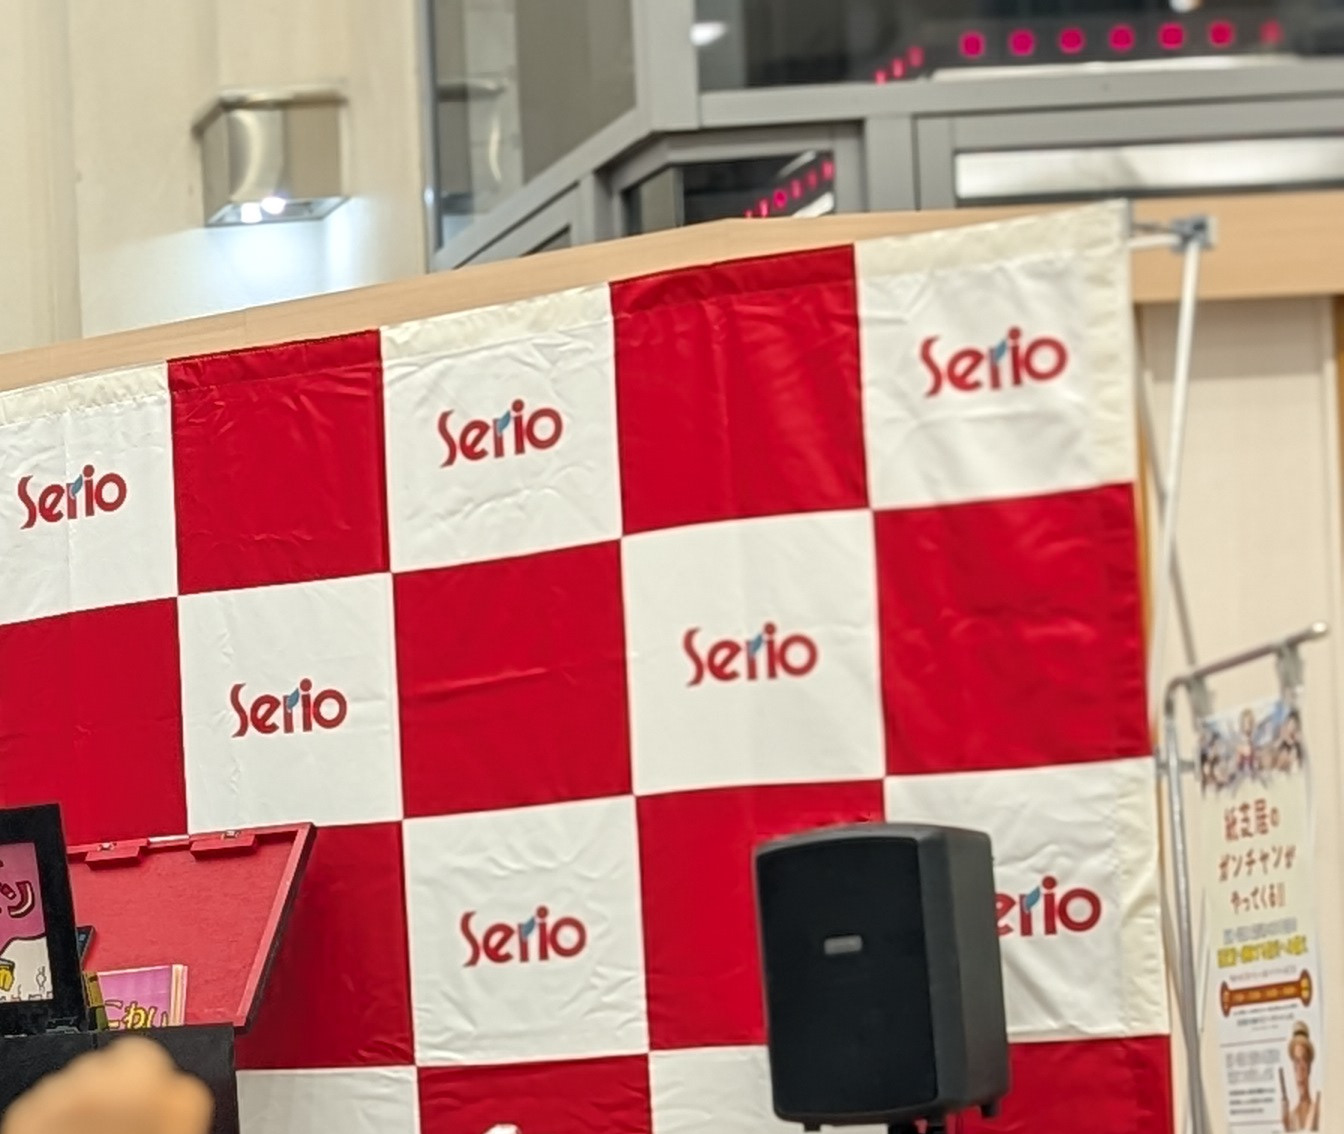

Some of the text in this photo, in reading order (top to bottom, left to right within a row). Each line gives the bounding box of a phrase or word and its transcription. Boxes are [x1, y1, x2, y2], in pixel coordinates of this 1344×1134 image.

[920, 327, 1069, 398] Serio
[437, 399, 564, 469] Serio
[17, 464, 127, 530] Serio
[683, 622, 818, 688] Serio
[231, 679, 348, 738] Serio
[460, 906, 588, 969] Serio
[996, 875, 1102, 937] erio
